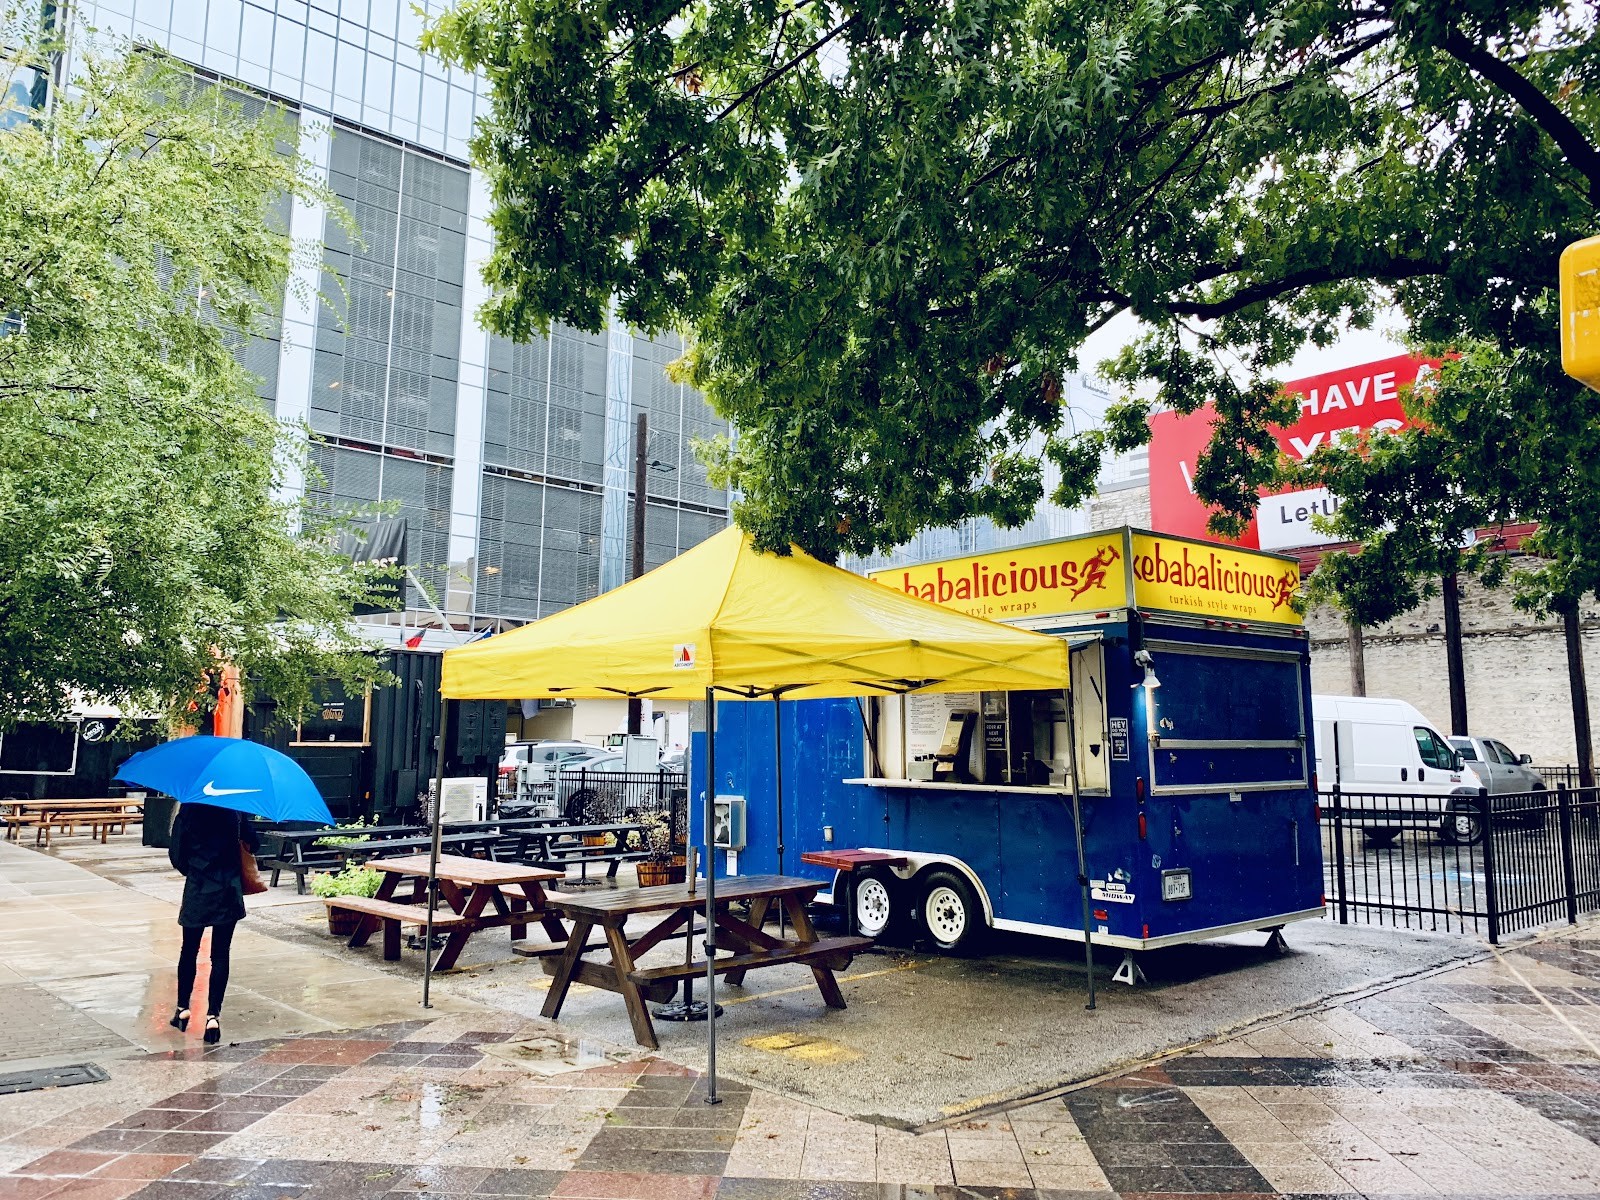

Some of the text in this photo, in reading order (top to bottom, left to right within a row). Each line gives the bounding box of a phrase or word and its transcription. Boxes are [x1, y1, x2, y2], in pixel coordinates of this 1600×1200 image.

[1297, 371, 1398, 418] HAVE
[873, 560, 1078, 604] babalicious
[965, 604, 994, 617] style
[999, 600, 1038, 615] wraps
[1169, 594, 1258, 616] turkish style wraps
[1111, 720, 1127, 729] HEY
